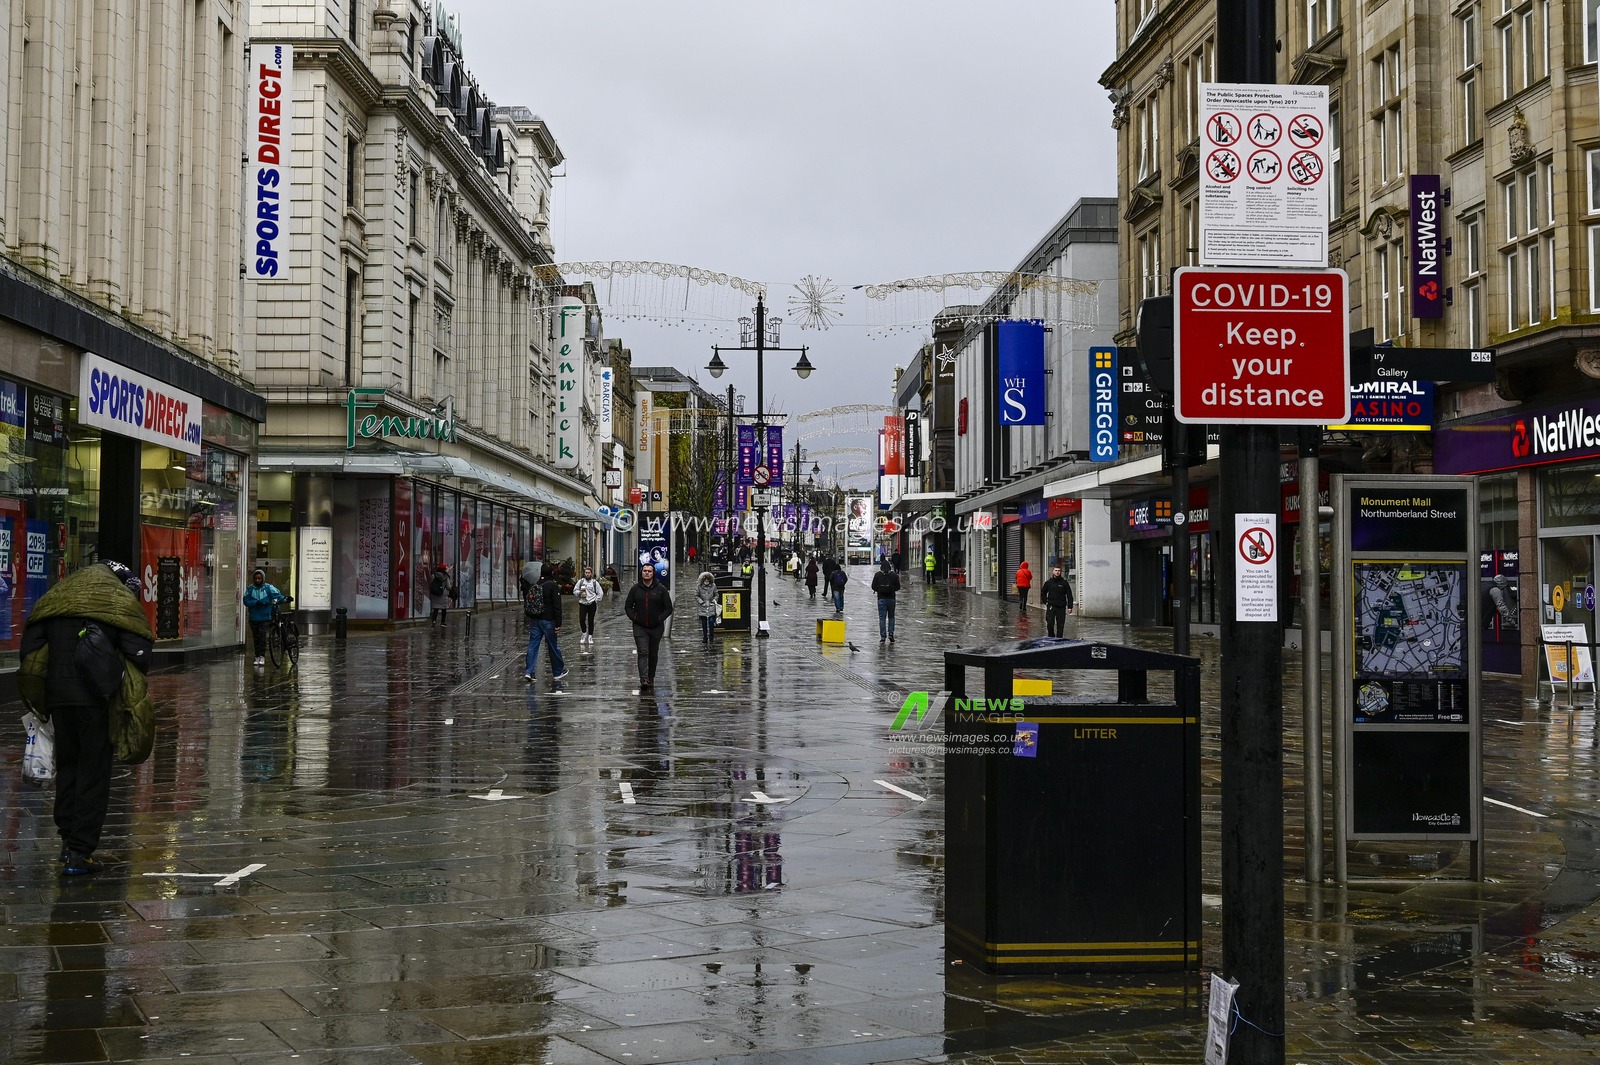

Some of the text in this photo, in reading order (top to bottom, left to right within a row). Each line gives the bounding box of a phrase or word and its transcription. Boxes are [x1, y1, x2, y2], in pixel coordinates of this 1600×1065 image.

[1417, 190, 1437, 276] NatWest
[1190, 283, 1332, 308] COVID-19
[1226, 321, 1297, 350] Keep
[1232, 358, 1293, 380] your
[1376, 367, 1409, 379] Gallery
[1004, 378, 1026, 388] WH
[1350, 380, 1426, 395] DMIRAL
[602, 381, 611, 423] BARCLAYS
[1201, 382, 1325, 407] distance
[1003, 388, 1027, 422] S
[1353, 401, 1422, 417] ASINO
[906, 412, 918, 420] JD
[1095, 372, 1113, 457] GREGGS
[1533, 407, 1600, 455] NatWes
[1360, 497, 1432, 507] Monument Mall
[1360, 508, 1457, 519] Northumberland Street
[28, 534, 45, 551] 20%
[28, 556, 43, 571] OFF
[1480, 553, 1493, 562] atWest
[1074, 728, 1117, 739] LITTER
[1412, 812, 1452, 822] Newcastle
